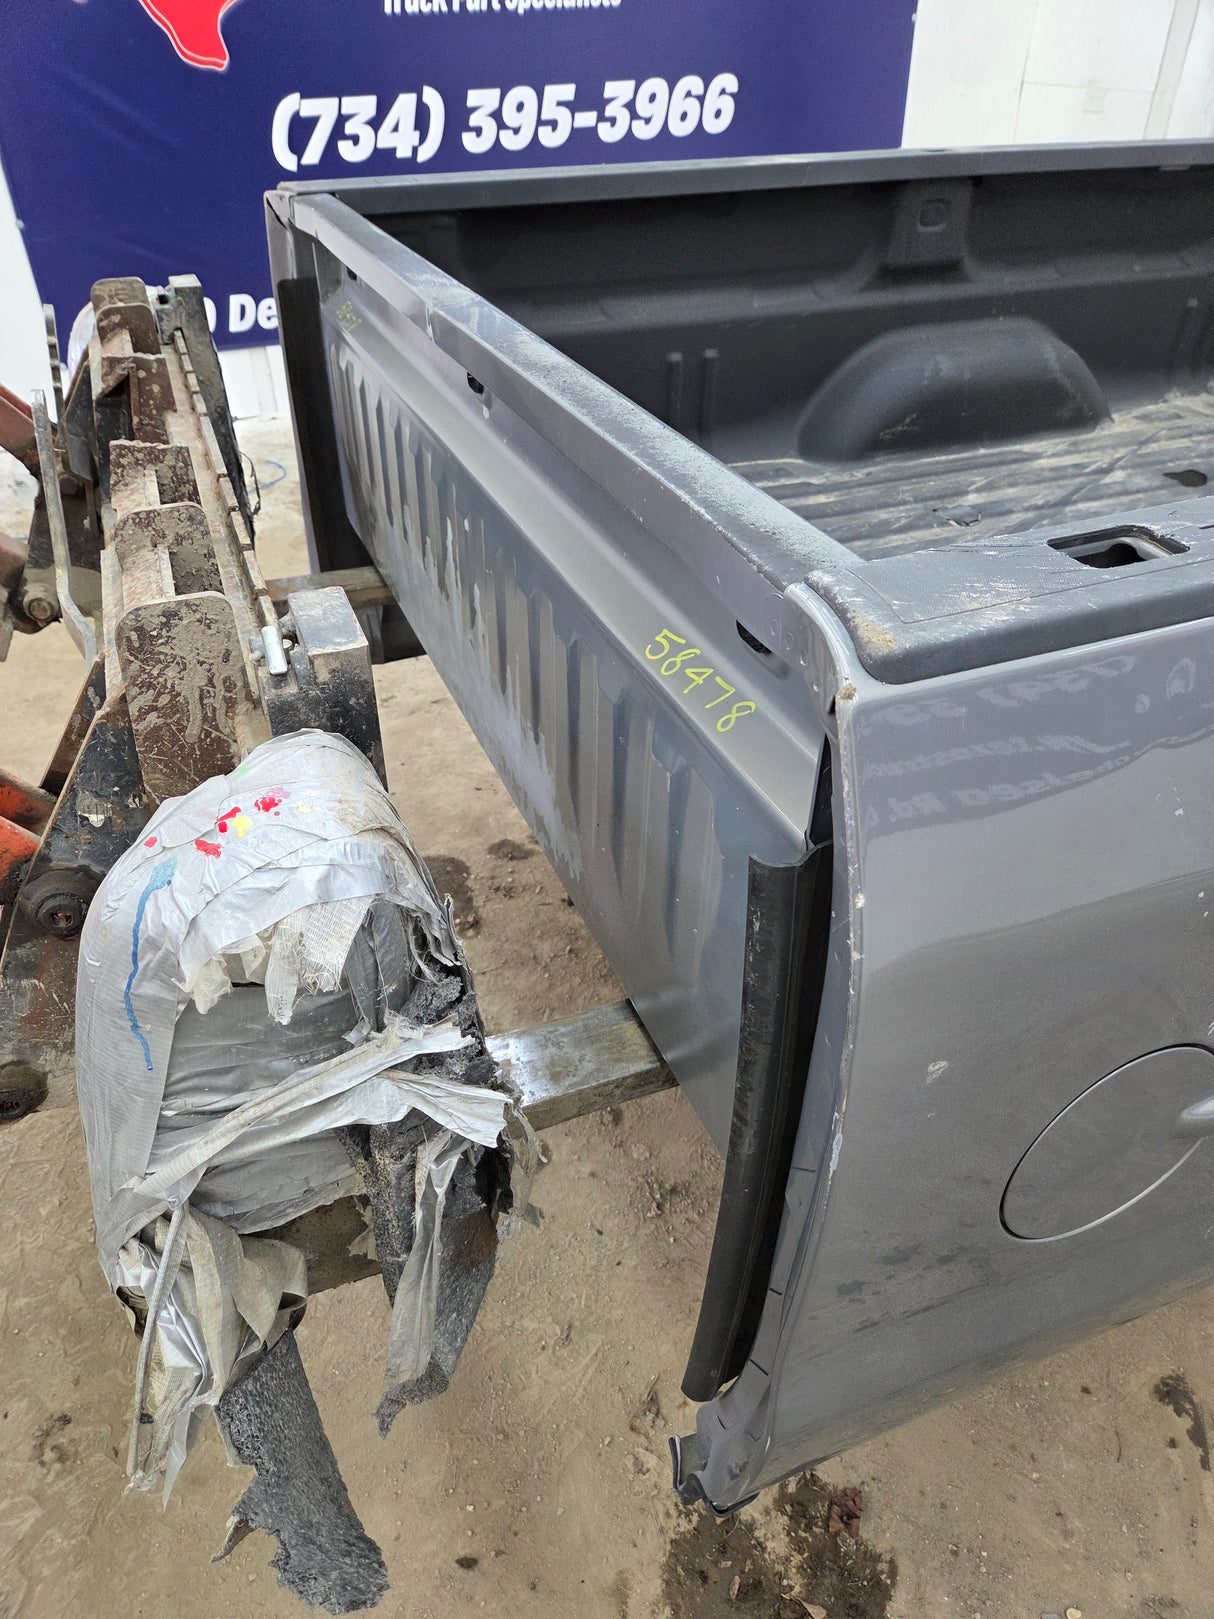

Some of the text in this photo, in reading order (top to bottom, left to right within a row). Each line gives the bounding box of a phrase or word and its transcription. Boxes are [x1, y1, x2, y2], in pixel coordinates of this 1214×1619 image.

[271, 73, 739, 172] (734) 395-3966
[645, 628, 756, 732] 58478
